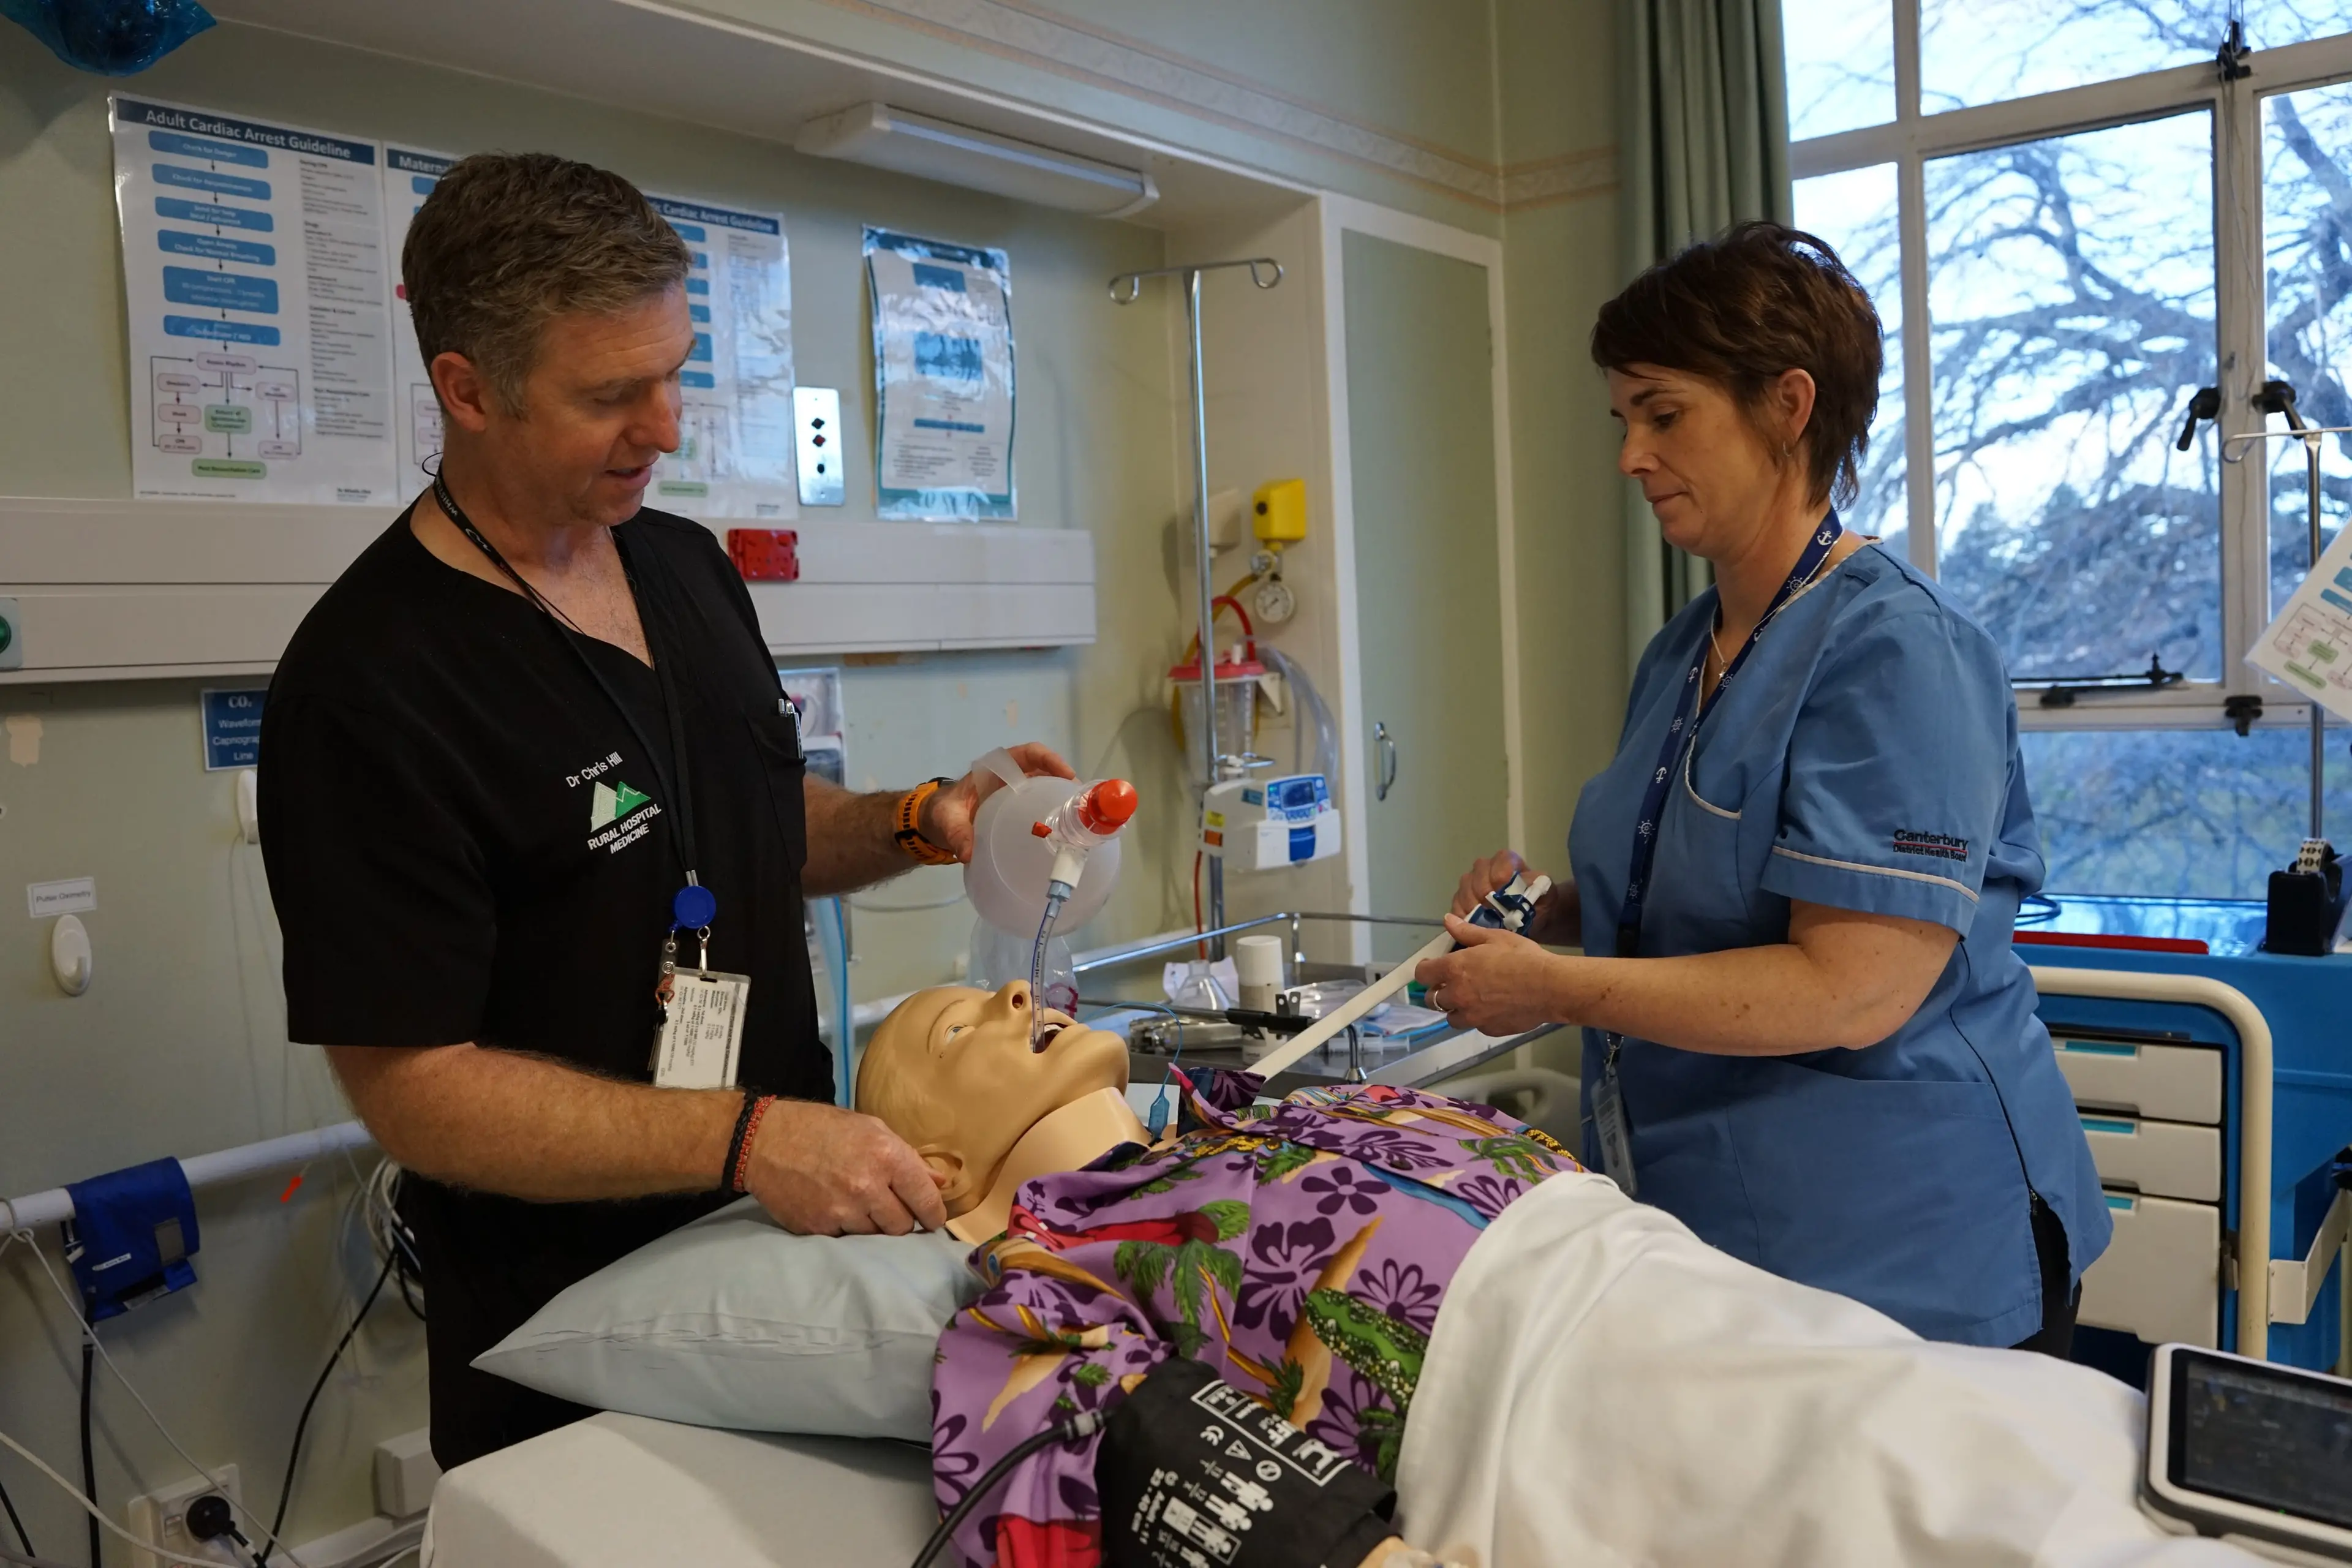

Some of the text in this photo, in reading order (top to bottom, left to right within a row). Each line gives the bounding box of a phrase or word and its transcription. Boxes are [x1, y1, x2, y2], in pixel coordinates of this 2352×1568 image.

[146, 110, 351, 159] Adult Cardiac Arrest Guideline
[565, 751, 623, 788] Dr Chris Hill
[587, 804, 662, 850] RURAL HOSPITAL
[609, 823, 649, 854] MEDICINE
[1894, 829, 1969, 850] Canterbury
[1893, 844, 1924, 856] District
[1925, 848, 1950, 859] Health
